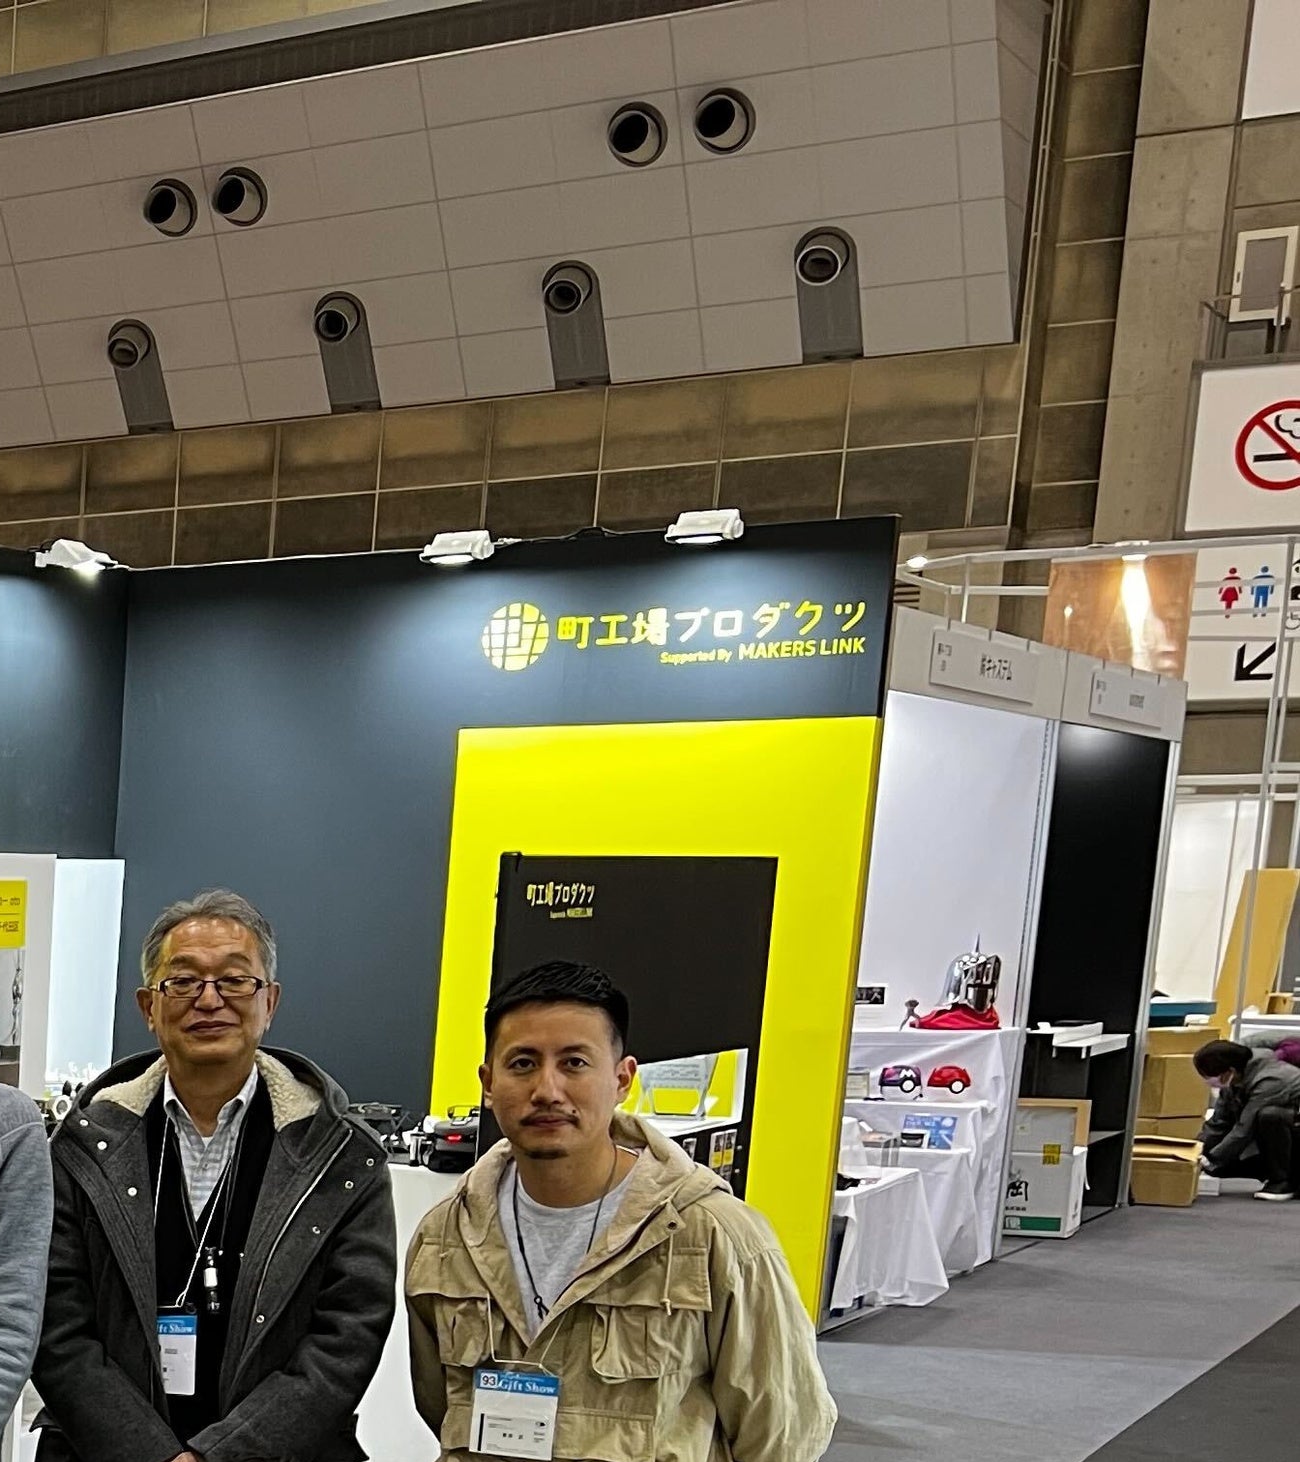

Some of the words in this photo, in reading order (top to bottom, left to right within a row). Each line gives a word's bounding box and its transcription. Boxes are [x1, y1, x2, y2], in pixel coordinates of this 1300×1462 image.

[557, 601, 866, 649] 町工場プロダクツ
[660, 648, 717, 665] Supported
[718, 649, 733, 664] By
[739, 639, 816, 660] MAKERS
[820, 637, 866, 655] LINK
[482, 1375, 496, 1386] 93
[499, 1380, 523, 1391] Gift
[525, 1381, 556, 1394] Show
